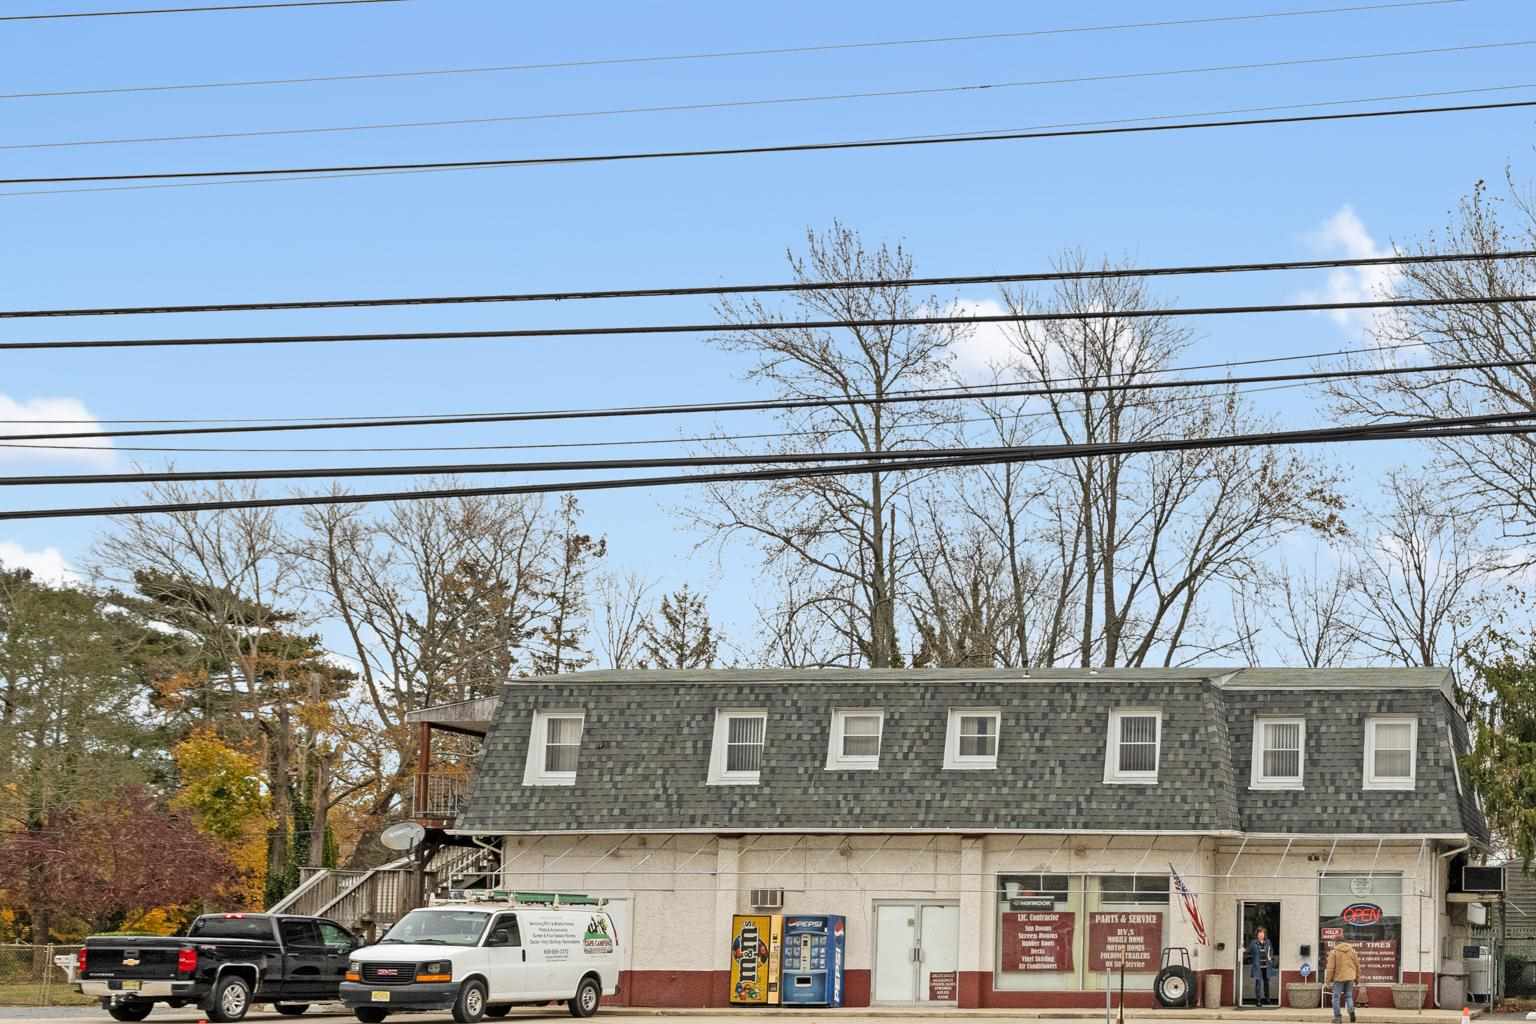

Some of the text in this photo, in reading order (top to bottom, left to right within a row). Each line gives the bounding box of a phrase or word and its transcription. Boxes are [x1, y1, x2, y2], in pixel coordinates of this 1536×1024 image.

[1095, 914, 1157, 923] PARTS & SERVICE
[1343, 908, 1380, 922] OPEN
